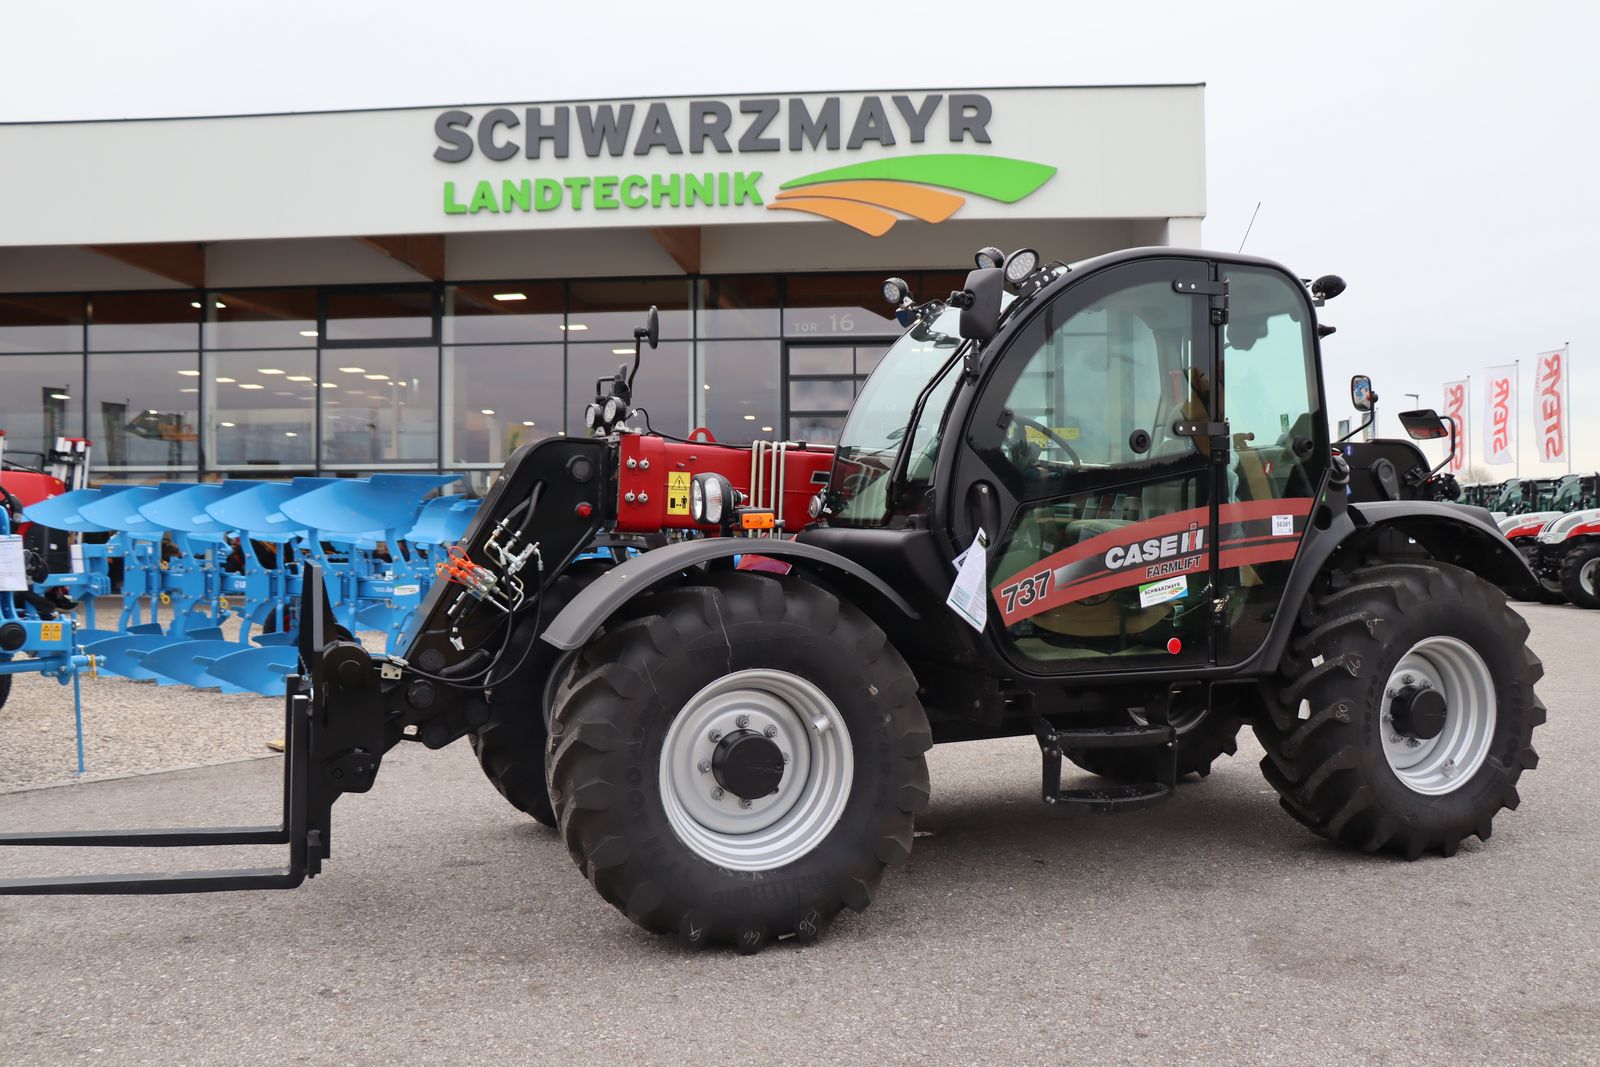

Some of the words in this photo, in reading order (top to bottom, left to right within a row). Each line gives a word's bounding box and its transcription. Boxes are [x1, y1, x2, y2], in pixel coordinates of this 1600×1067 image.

[433, 93, 993, 163] SCHWARZMAYR
[443, 171, 764, 215] LANDTECHNIK
[794, 322, 818, 333] TOR
[829, 313, 854, 332] 16
[1104, 536, 1179, 570] CASE
[1145, 555, 1202, 579] FARMLIFT
[1001, 569, 1052, 614] 737
[1144, 582, 1181, 595] SCHWARZMAYR
